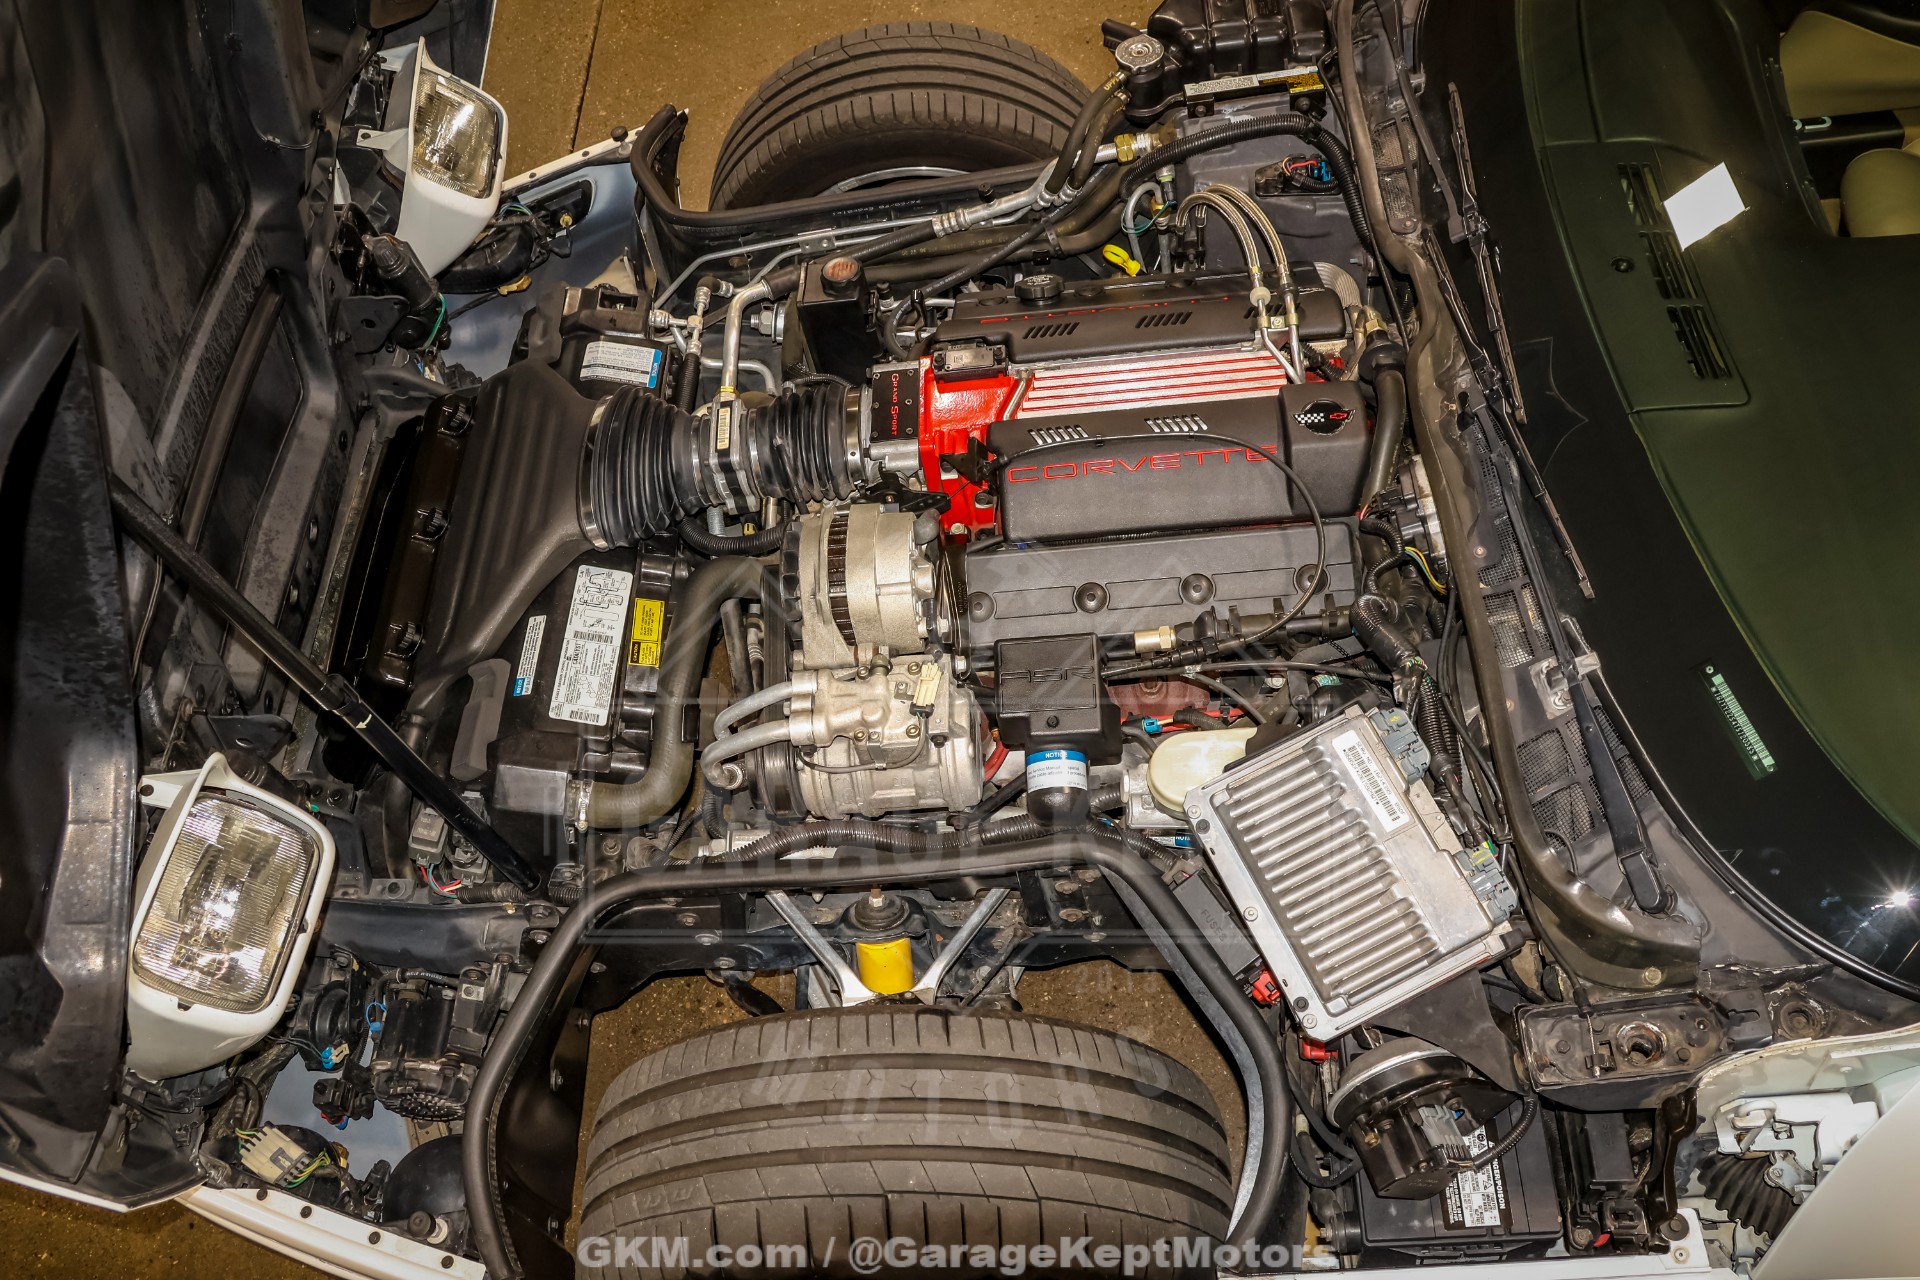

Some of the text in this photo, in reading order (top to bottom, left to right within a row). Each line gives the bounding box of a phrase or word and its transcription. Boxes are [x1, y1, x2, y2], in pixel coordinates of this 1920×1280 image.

[890, 405, 899, 436] SPORT
[1008, 445, 1277, 483] CORVETTE
[631, 643, 639, 661] CAUTION
[1000, 665, 1096, 685] ASR
